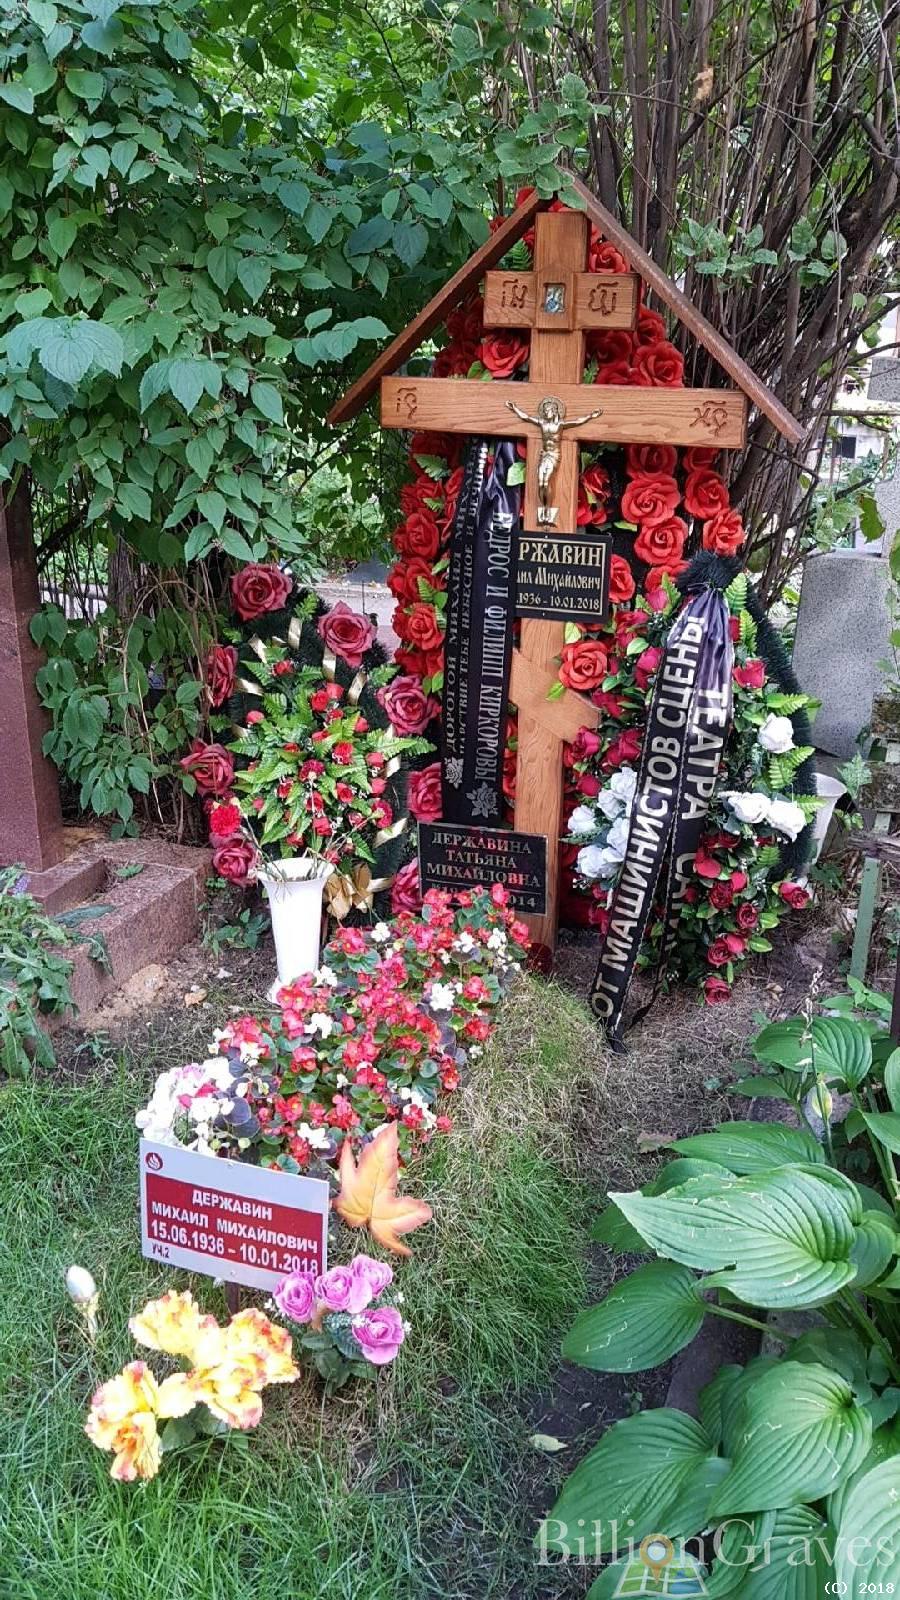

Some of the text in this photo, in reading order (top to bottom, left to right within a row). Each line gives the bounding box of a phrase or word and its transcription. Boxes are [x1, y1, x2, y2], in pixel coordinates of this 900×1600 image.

[517, 541, 602, 567] РЖАВИН
[461, 544, 473, 629] НЕБЕСНОЕ
[516, 592, 541, 605] .1936
[550, 595, 600, 610] 10.01.2018
[475, 512, 513, 782] БЕДРОС И ФИЛИПП КИРКОРОВЫ
[656, 616, 706, 728] СЦЕНЫ
[446, 656, 457, 753] ДОРОГОЙ
[682, 683, 728, 820] ТЕАТРА
[431, 831, 532, 854] ДЕРЖАВИНА
[445, 849, 517, 868] ТАТЬЯНА
[602, 736, 681, 972] МАШИНИСТОВ
[426, 862, 540, 887] МИХАЙЛОВНА
[592, 972, 620, 1018] ОТ
[151, 1201, 318, 1254] МИХАИЛ МИХАЙЛОВИЧ
[192, 1189, 272, 1221] ДЕРЖАВИН
[151, 1219, 225, 1255] 15.06.1936
[240, 1243, 318, 1277] 10.01.2018
[151, 1243, 170, 1259] УЧ.2
